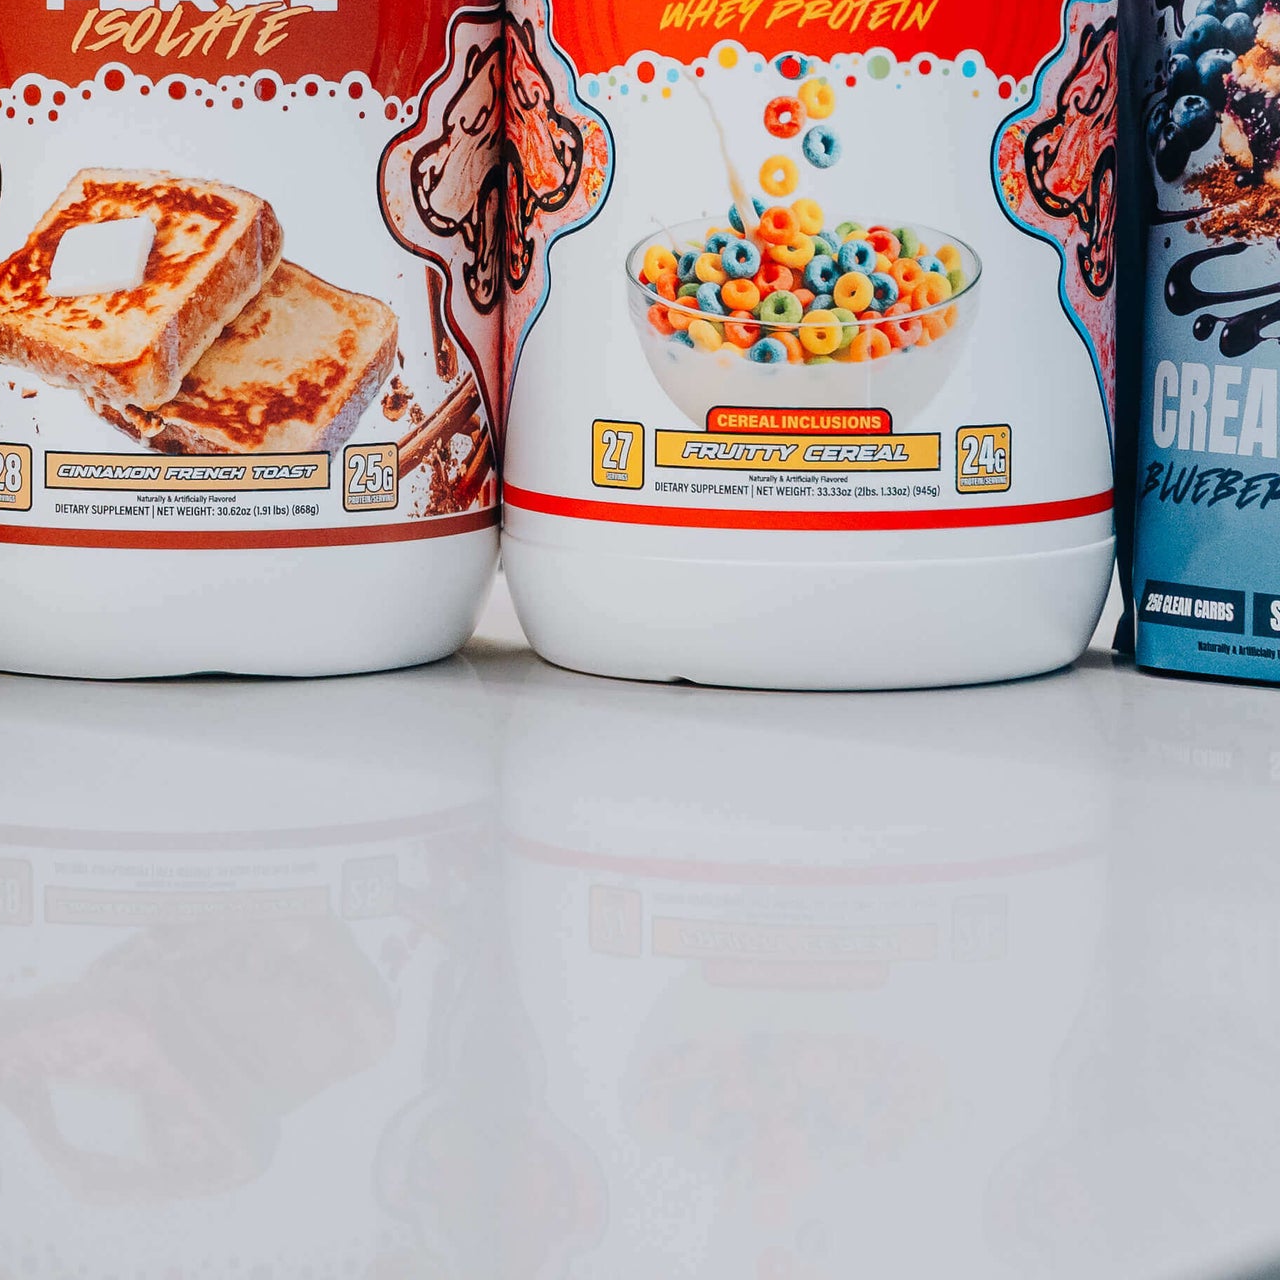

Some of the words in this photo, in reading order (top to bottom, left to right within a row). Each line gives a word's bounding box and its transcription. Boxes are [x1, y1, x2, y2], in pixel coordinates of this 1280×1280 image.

[71, 1, 314, 58] ISOLATE
[717, 414, 779, 429] CEREAL
[782, 415, 882, 430] INCLUSIONS
[602, 430, 633, 470] 27
[682, 441, 798, 461] FRUITTY
[803, 444, 909, 462] CEREAL
[961, 435, 1006, 476] 24G
[57, 464, 160, 480] CINNAMON
[164, 466, 246, 480] FRENCH
[252, 464, 317, 480] TOAST
[348, 453, 393, 494] 25G
[748, 475, 778, 484] Naturally
[786, 475, 819, 484] Artificially
[820, 475, 848, 483] Flavored
[137, 495, 165, 504] Naturally
[174, 495, 207, 504] Artificially
[208, 495, 236, 503] Flavored
[655, 482, 689, 493] DIETARY
[691, 483, 749, 495] SUPPLEMENT
[756, 486, 773, 496] NET
[776, 486, 815, 497] WEIGHT:
[817, 487, 852, 497] 33.33oz
[854, 486, 879, 498] (2lbs.
[880, 486, 910, 498] 1.33oz)
[912, 485, 940, 497] (945g)
[55, 503, 89, 514] DIETARY
[91, 504, 149, 516] SUPPLEMENT
[157, 506, 174, 516] NET
[176, 506, 215, 516] WEIGHT:
[217, 506, 251, 516] 30.62oz
[253, 505, 271, 517] (1.91
[273, 505, 290, 517] lbs)
[292, 504, 320, 516] (868g)
[1145, 593, 1163, 612] 25G
[1162, 595, 1192, 617] CLEAN
[1194, 599, 1234, 621] CARBS
[1198, 641, 1231, 655] Naturally
[1238, 645, 1276, 660] Artificially
